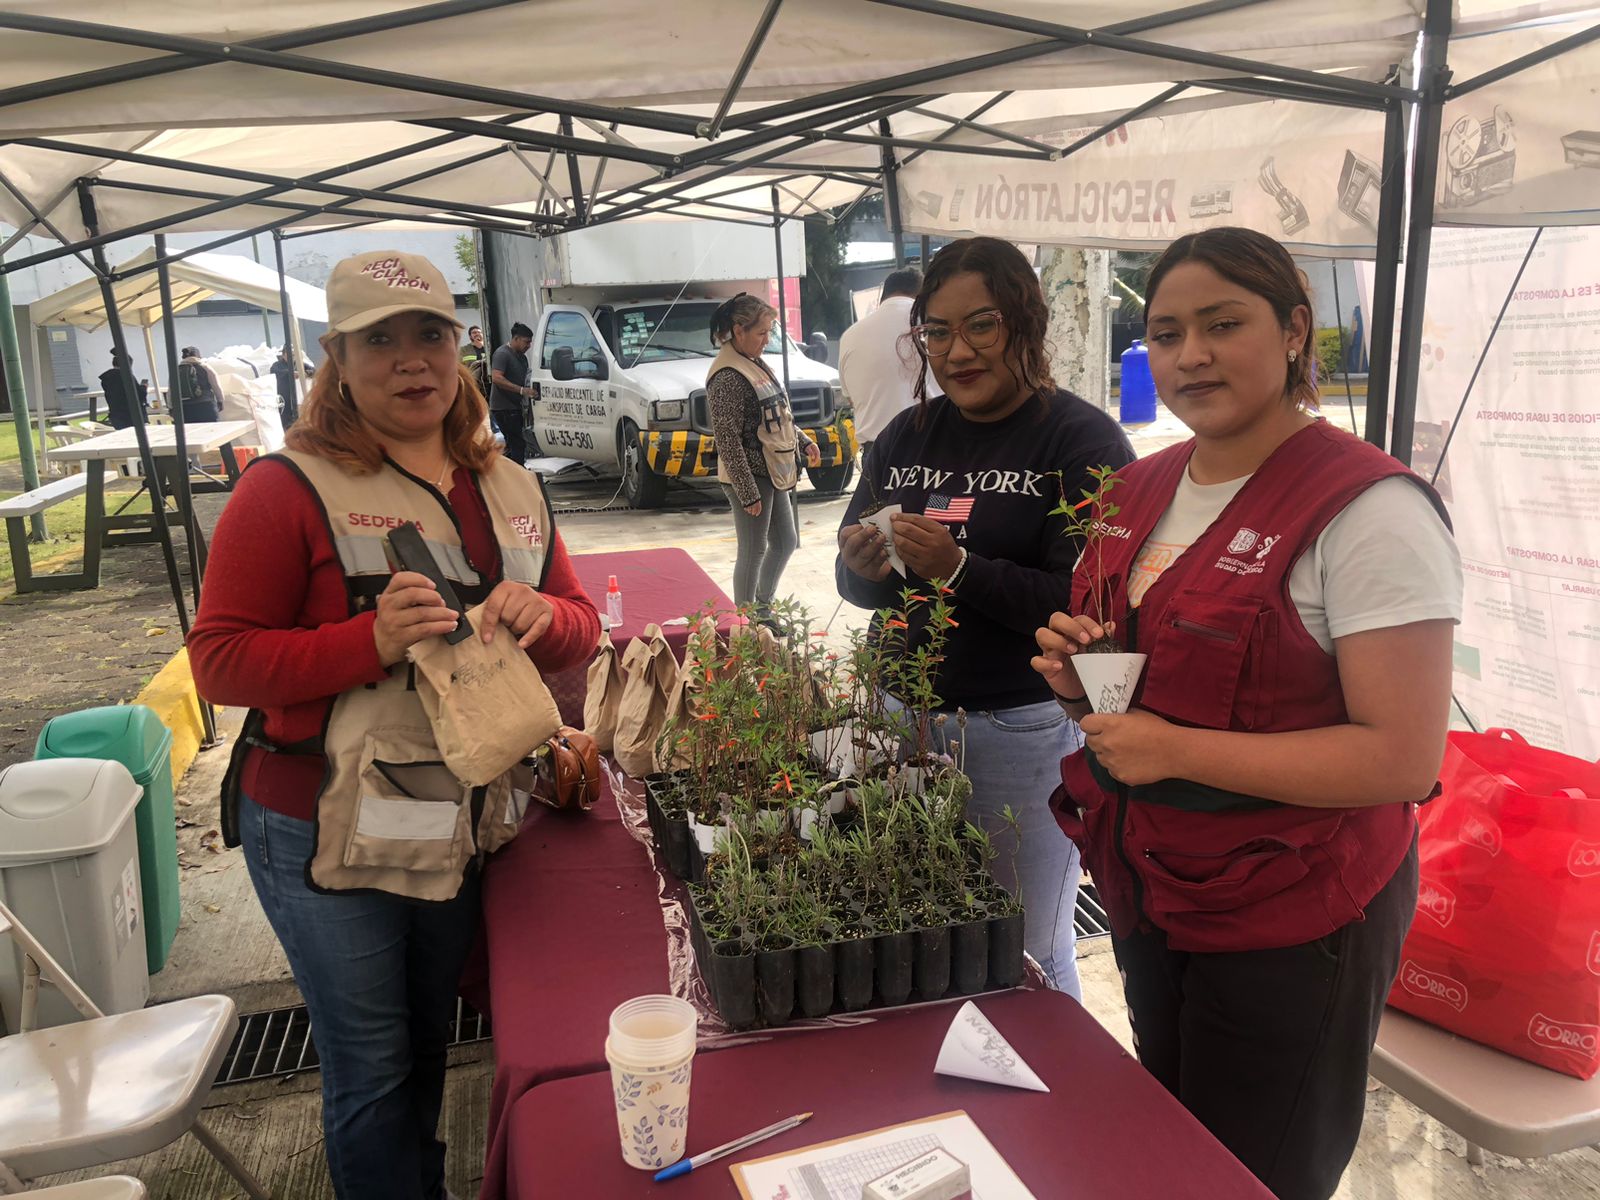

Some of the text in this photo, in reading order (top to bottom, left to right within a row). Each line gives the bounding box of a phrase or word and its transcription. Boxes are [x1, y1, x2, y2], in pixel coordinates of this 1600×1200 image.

[361, 257, 401, 273] RECI
[372, 266, 407, 279] CLA
[387, 276, 430, 291] TRÓN
[565, 388, 594, 402] MERCANTIL
[597, 390, 604, 402] DE
[576, 404, 583, 415] DE
[586, 404, 607, 417] CARGA
[545, 429, 593, 450] LH-33-580
[884, 465, 1043, 497] NEW YORK
[516, 523, 537, 535] CLA
[1406, 968, 1461, 1002] ZORRO
[1535, 1021, 1596, 1050] ZORRO
